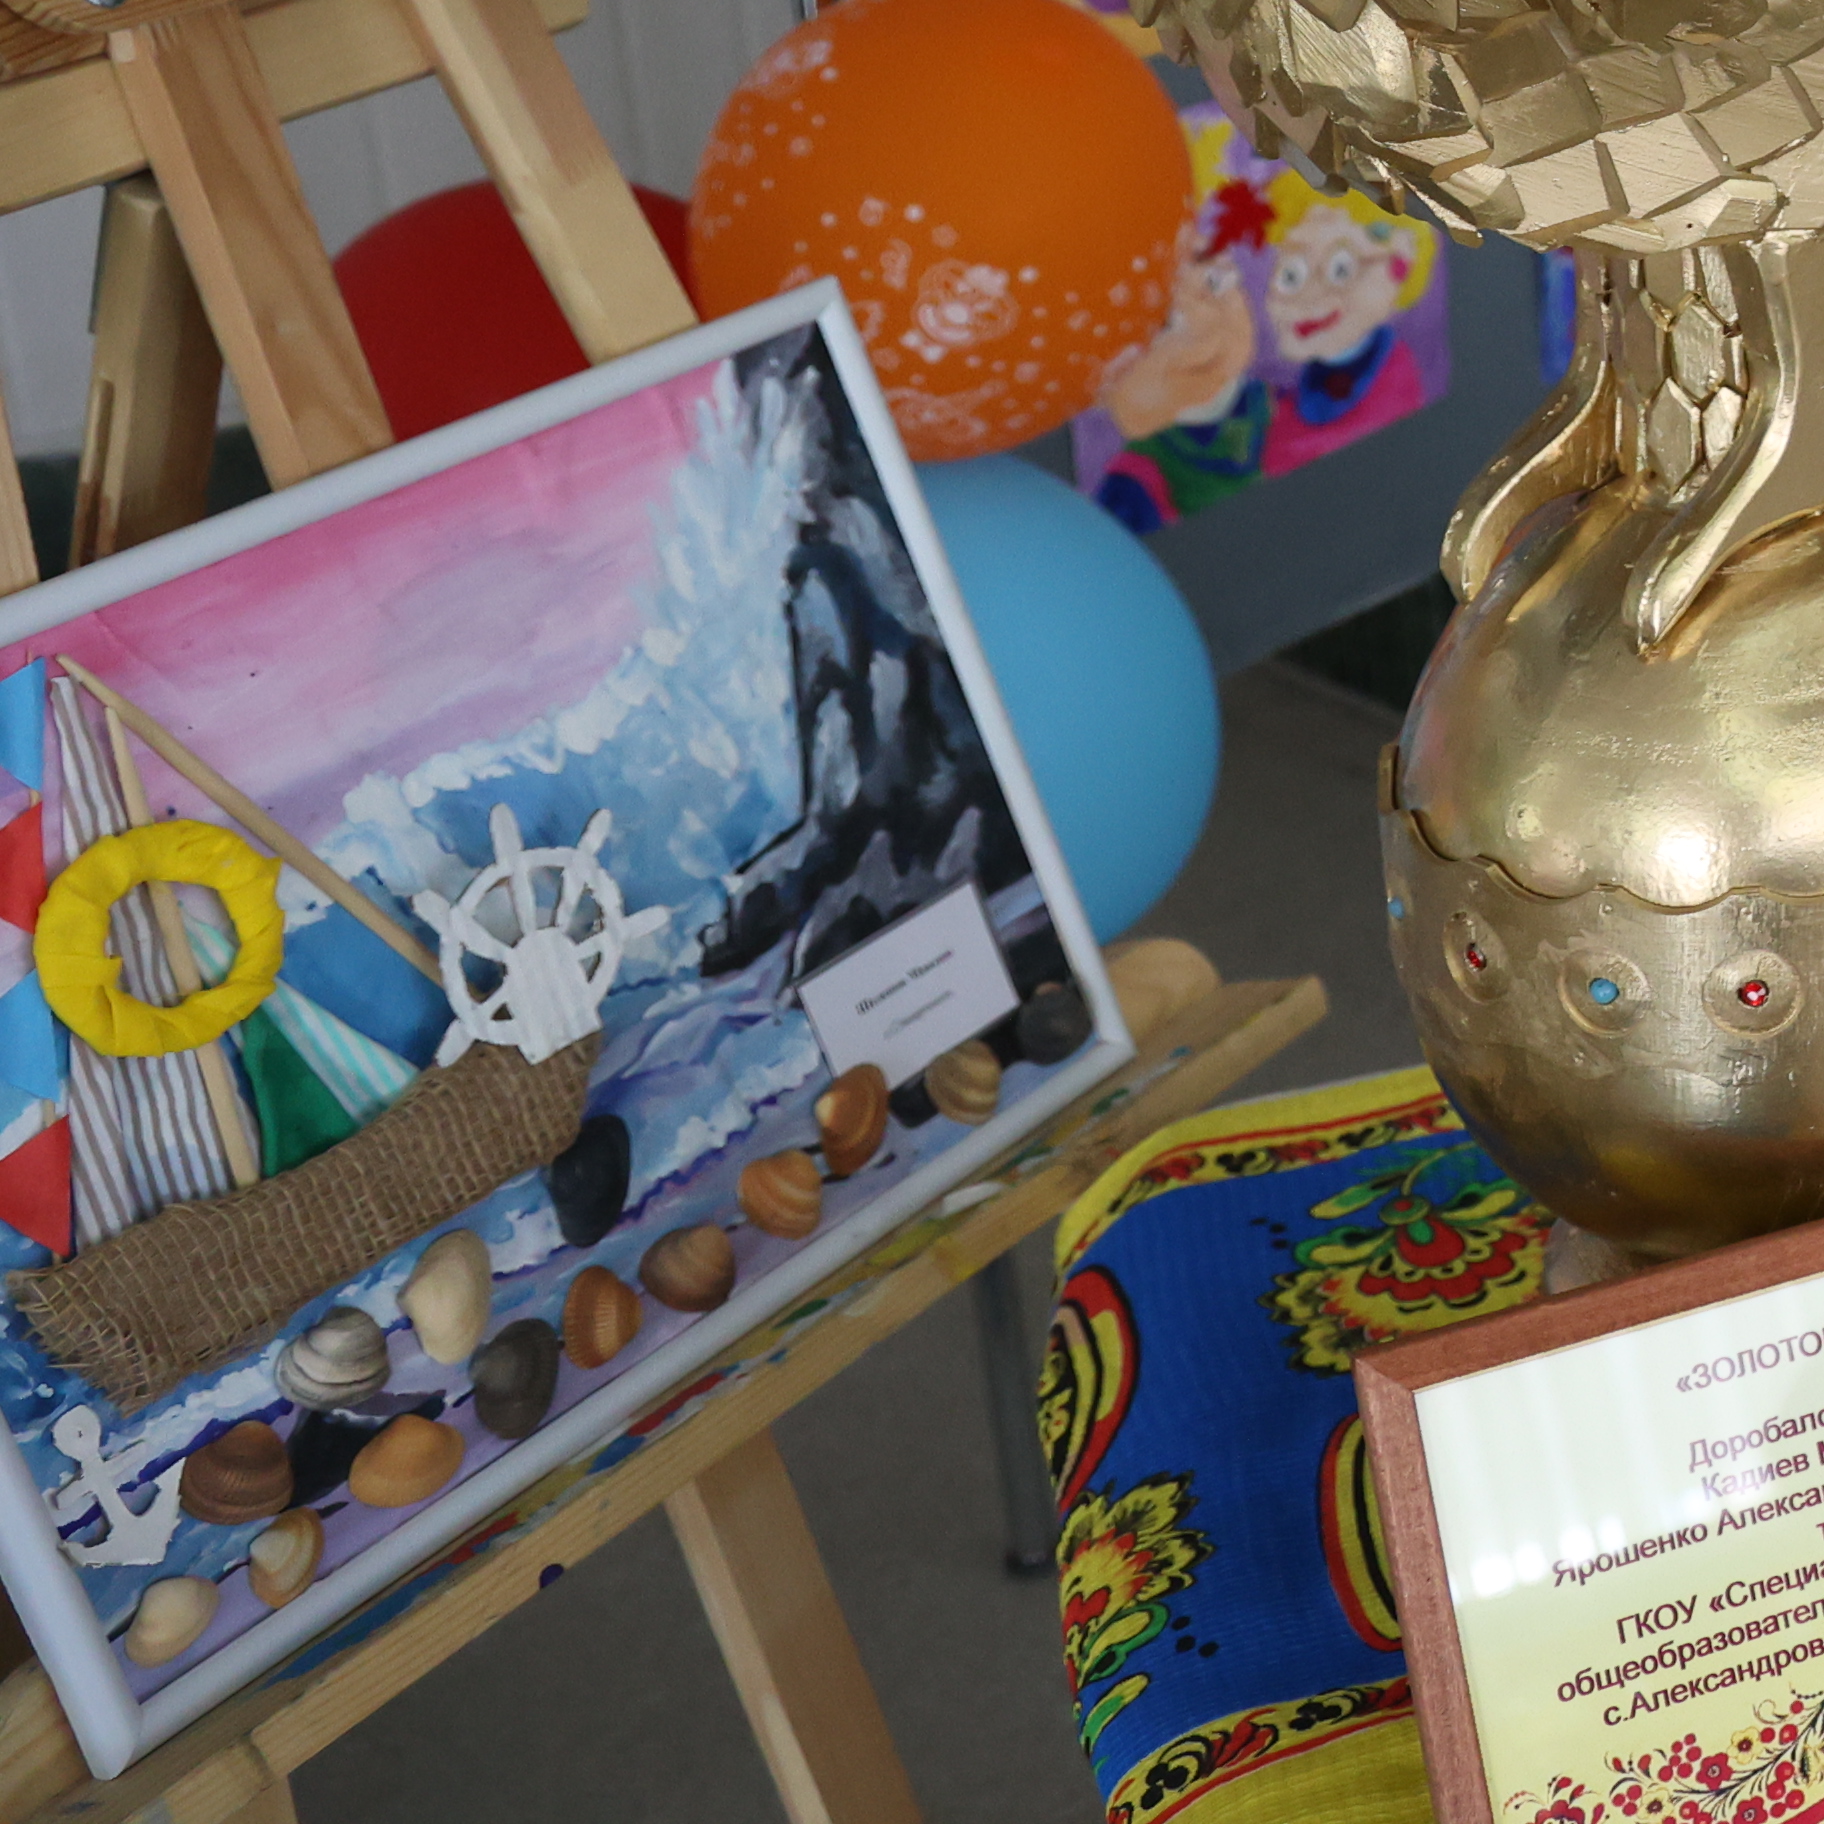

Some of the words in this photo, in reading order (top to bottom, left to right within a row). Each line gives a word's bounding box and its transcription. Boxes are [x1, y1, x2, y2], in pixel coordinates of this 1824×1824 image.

[1700, 1451, 1810, 1503] Кадиев
[1552, 1522, 1709, 1588] Ярошенко
[1615, 1593, 1698, 1645] ГКОУ
